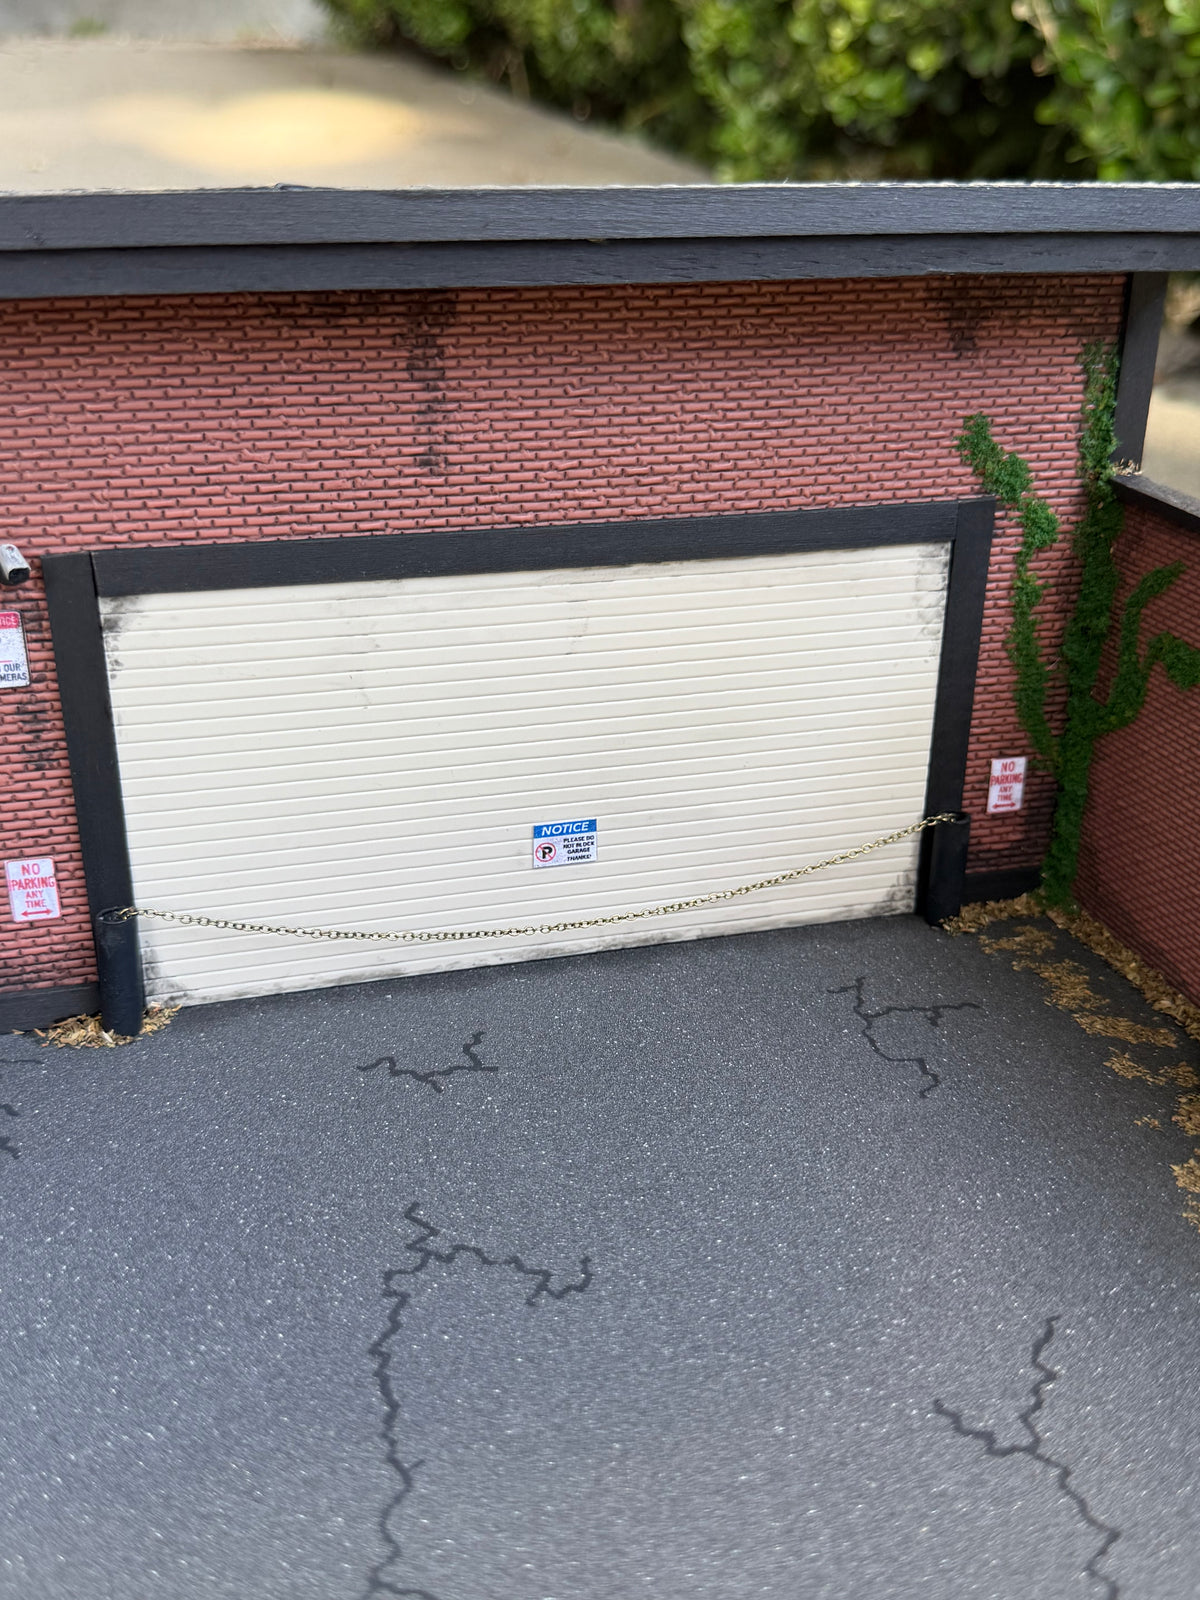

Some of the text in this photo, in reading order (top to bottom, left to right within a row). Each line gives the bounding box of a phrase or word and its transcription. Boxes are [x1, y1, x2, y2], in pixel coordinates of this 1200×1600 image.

[4, 663, 21, 672] OUR
[0, 672, 27, 682] MERAS
[1001, 761, 1015, 773] NO
[990, 772, 1023, 787] PARKING
[998, 785, 1013, 793] ANY
[541, 821, 590, 836] NOTICE
[563, 836, 585, 844] PLEASE
[566, 847, 590, 855] GARAGE
[21, 863, 41, 876] NO
[10, 875, 55, 891] PARKING
[25, 890, 43, 899] ANY
[25, 899, 47, 908] TIME
